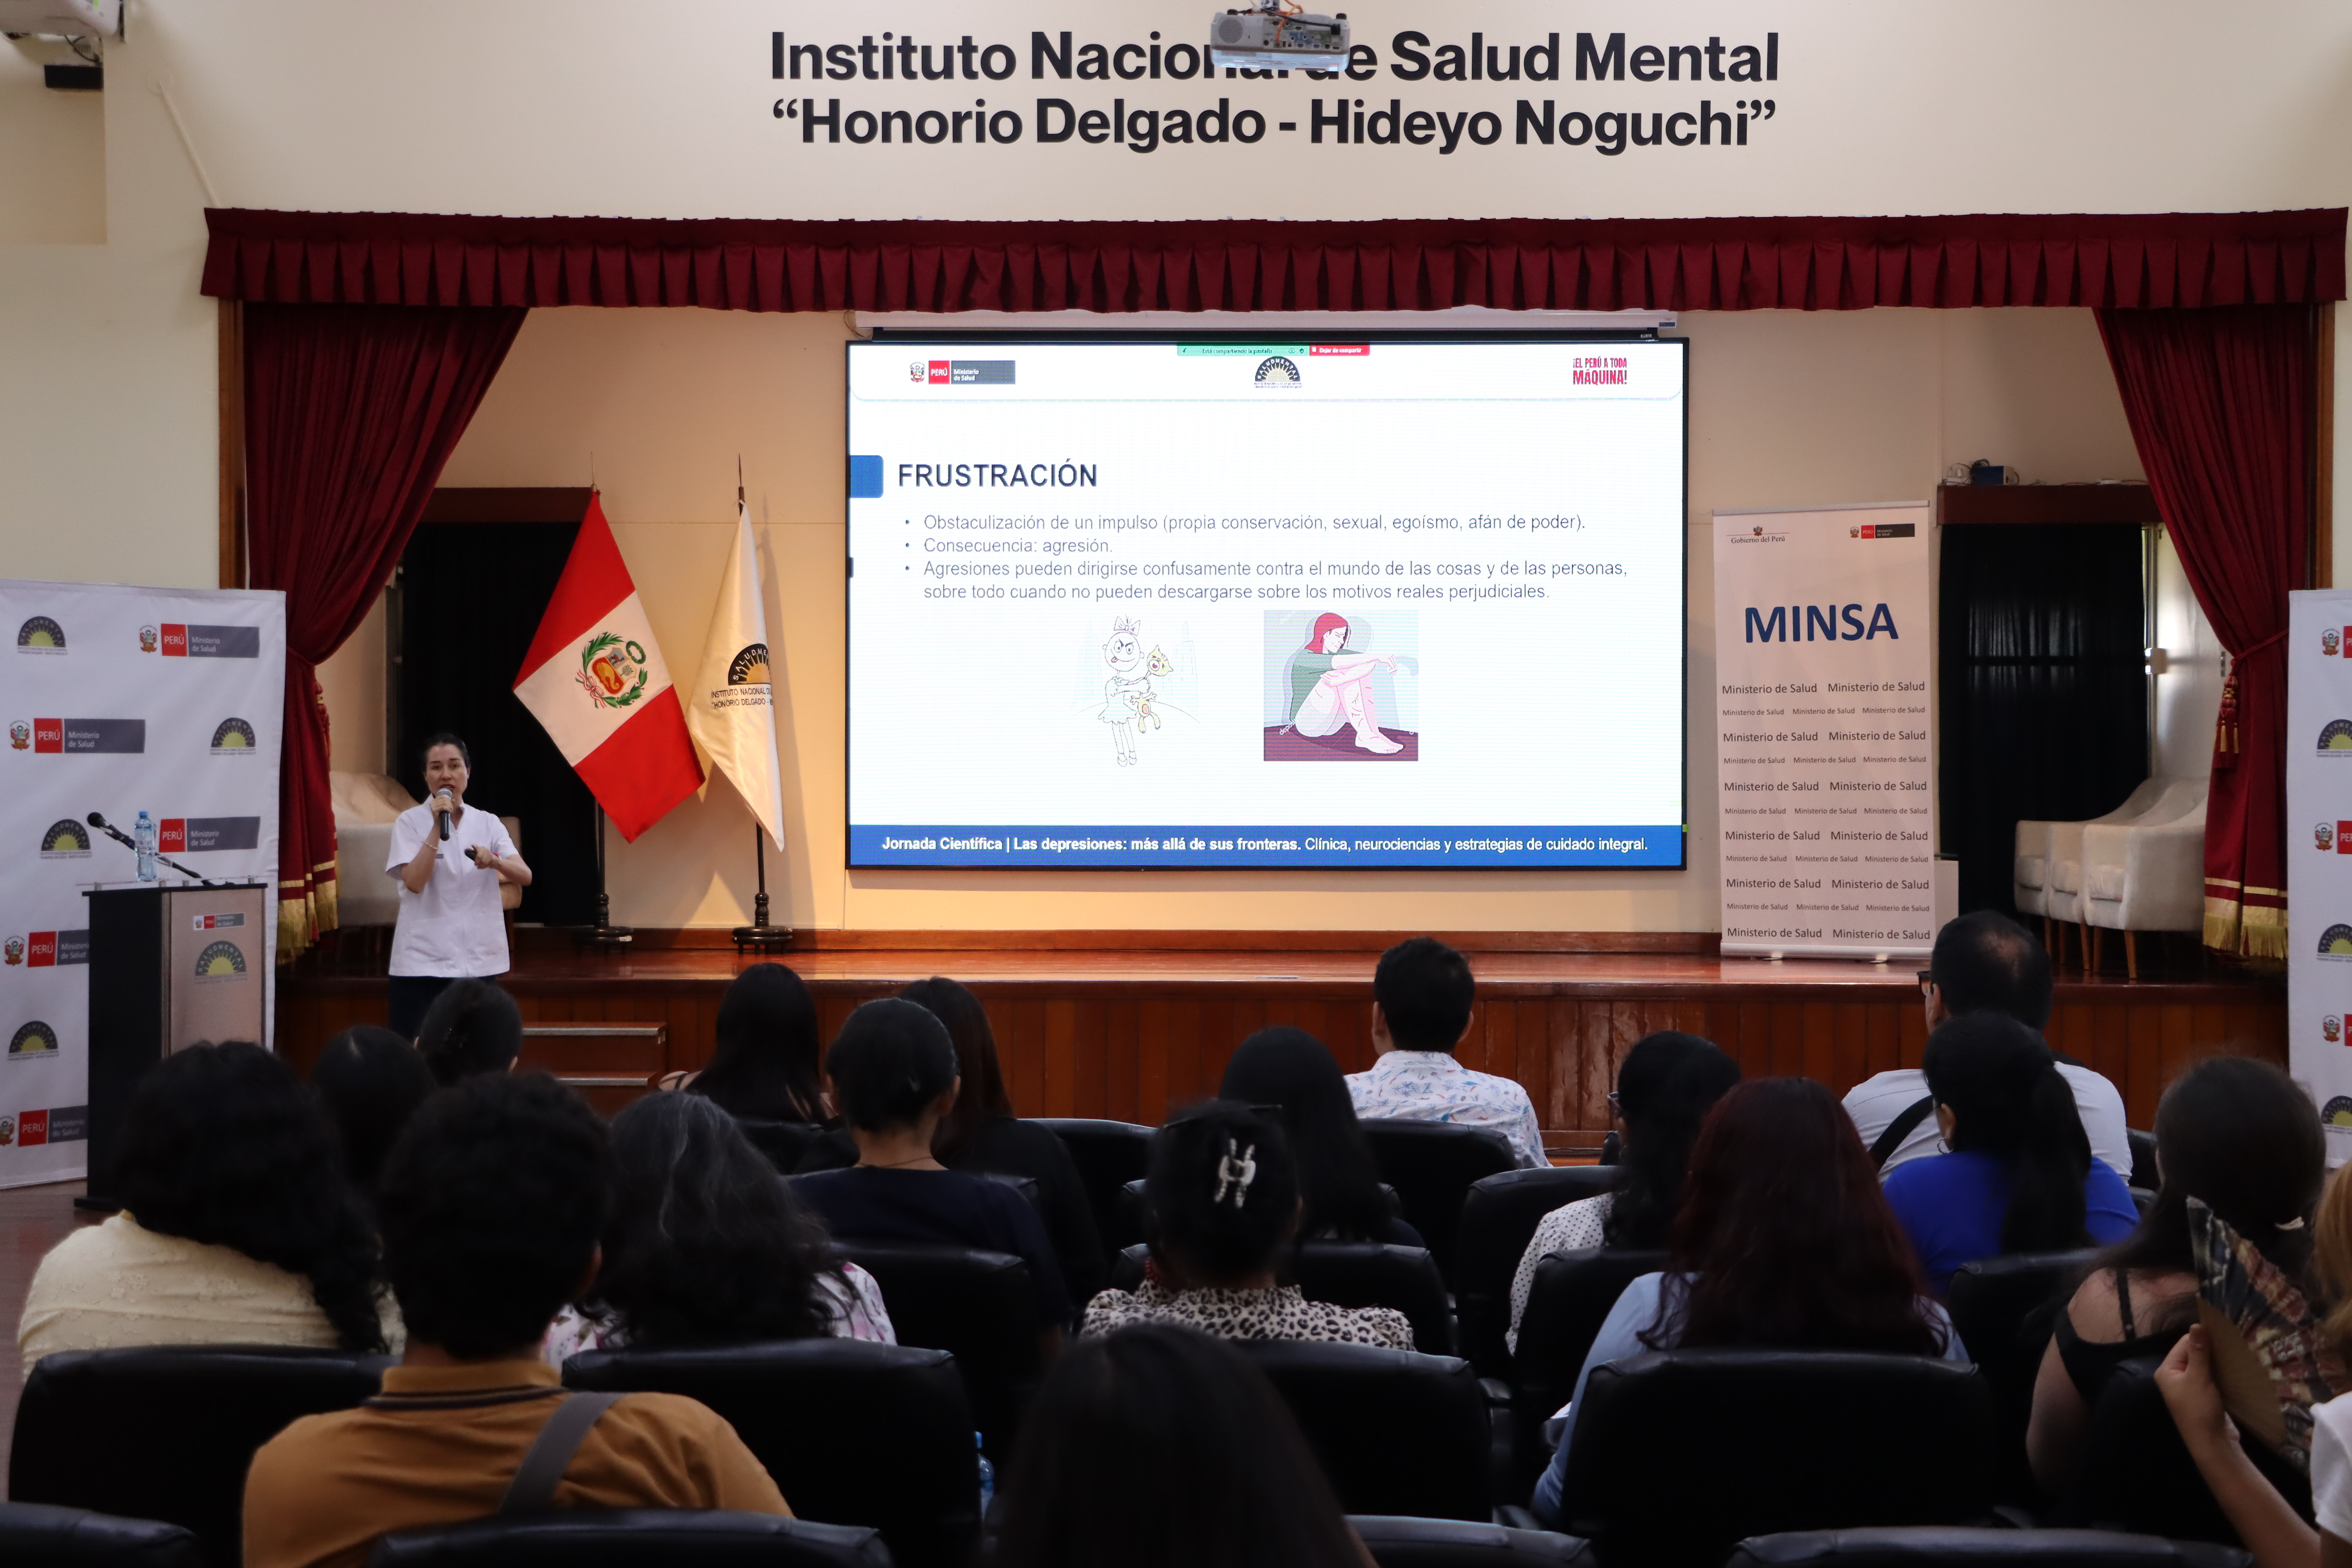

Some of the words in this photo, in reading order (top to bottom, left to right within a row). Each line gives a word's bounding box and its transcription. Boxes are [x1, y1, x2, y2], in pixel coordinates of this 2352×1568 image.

[772, 31, 1016, 80] Instituto
[1391, 31, 1559, 81] Salud
[1576, 33, 1778, 81] Mental
[774, 99, 1022, 144] “Honorio
[1037, 98, 1266, 153] Delgado
[1279, 122, 1296, 131] -
[1311, 99, 1501, 154] Hideyo
[1517, 100, 1775, 155] Noguchi”
[1585, 356, 1601, 368] PERÚ
[1604, 358, 1608, 368] A
[1610, 358, 1627, 368] TODA
[931, 368, 948, 376] PERÚ
[1573, 369, 1627, 385] MÁQUINA!
[900, 459, 1096, 487] FRUSTRACIÓN
[925, 515, 1044, 529] Obstaculización
[1051, 515, 1069, 529] de
[1076, 518, 1092, 529] un
[1099, 515, 1157, 533] impulso
[1164, 515, 1215, 533] (propia
[1222, 515, 1326, 531] conservación,
[1333, 514, 1386, 531] sexual,
[1393, 515, 1462, 533] egoísmo,
[1469, 514, 1501, 528] afán
[1508, 514, 1525, 528] de
[1532, 514, 1585, 532] poder).
[924, 538, 1036, 552] Consecuencia:
[1043, 538, 1112, 556] agresión.
[924, 561, 1009, 579] Agresiones
[1016, 561, 1071, 579] pueden
[1078, 561, 1137, 579] dirigirse
[1144, 561, 1250, 575] confusamente
[1256, 562, 1303, 575] contra
[1310, 561, 1321, 575] el
[1328, 561, 1379, 575] mundo
[1386, 561, 1403, 575] de
[1411, 561, 1431, 575] las
[1437, 564, 1481, 575] cosas
[1487, 564, 1495, 579] y
[1501, 561, 1519, 575] de
[1525, 561, 1545, 575] las
[1552, 564, 1626, 578] personas,
[925, 584, 966, 598] sobre
[972, 585, 1004, 598] todo
[1010, 584, 1066, 598] cuando
[1073, 588, 1090, 598] no
[1097, 584, 1152, 602] pueden
[1158, 584, 1252, 602] descargarse
[1258, 584, 1300, 598] sobre
[1307, 584, 1326, 598] los
[1333, 584, 1391, 598] motivos
[1397, 584, 1443, 598] reales
[1450, 584, 1548, 602] perjudiciales.
[1745, 604, 1898, 643] MINSA
[164, 635, 185, 645] PERÚ
[1723, 685, 1772, 694] Ministerio
[1775, 684, 1787, 693] de
[1790, 684, 1816, 692] Salud
[1829, 683, 1879, 692] Ministerio
[1883, 682, 1894, 691] de
[1898, 681, 1924, 691] Salud
[711, 689, 738, 698] INSTITUTO
[38, 730, 60, 740] PERÚ
[163, 829, 183, 840] PERÚ
[1726, 831, 1775, 840] Ministerio
[1778, 831, 1789, 840] de
[1793, 831, 1819, 840] Salud
[882, 837, 936, 849] Jornada
[940, 837, 1002, 849] Científica
[1014, 837, 1037, 849] Las
[1042, 837, 1127, 853] depresiones:
[1131, 837, 1158, 850] más
[1163, 837, 1186, 850] allá
[1190, 838, 1206, 850] de
[1210, 841, 1233, 850] sus
[1237, 838, 1301, 850] fronteras.
[1305, 838, 1350, 852] Clínica,
[1355, 838, 1441, 850] neurociencias
[1444, 841, 1451, 853] y
[1455, 838, 1523, 853] estrategias
[1527, 838, 1542, 850] de
[1546, 838, 1594, 850] cuidado
[1599, 838, 1647, 853] integral.
[1833, 930, 1884, 938] Ministerio
[1887, 930, 1899, 939] de
[1903, 930, 1930, 939] Salud
[32, 942, 53, 954] PERÚ
[198, 944, 244, 972] SALUDMENTAL
[23, 1121, 45, 1133] PERÚ
